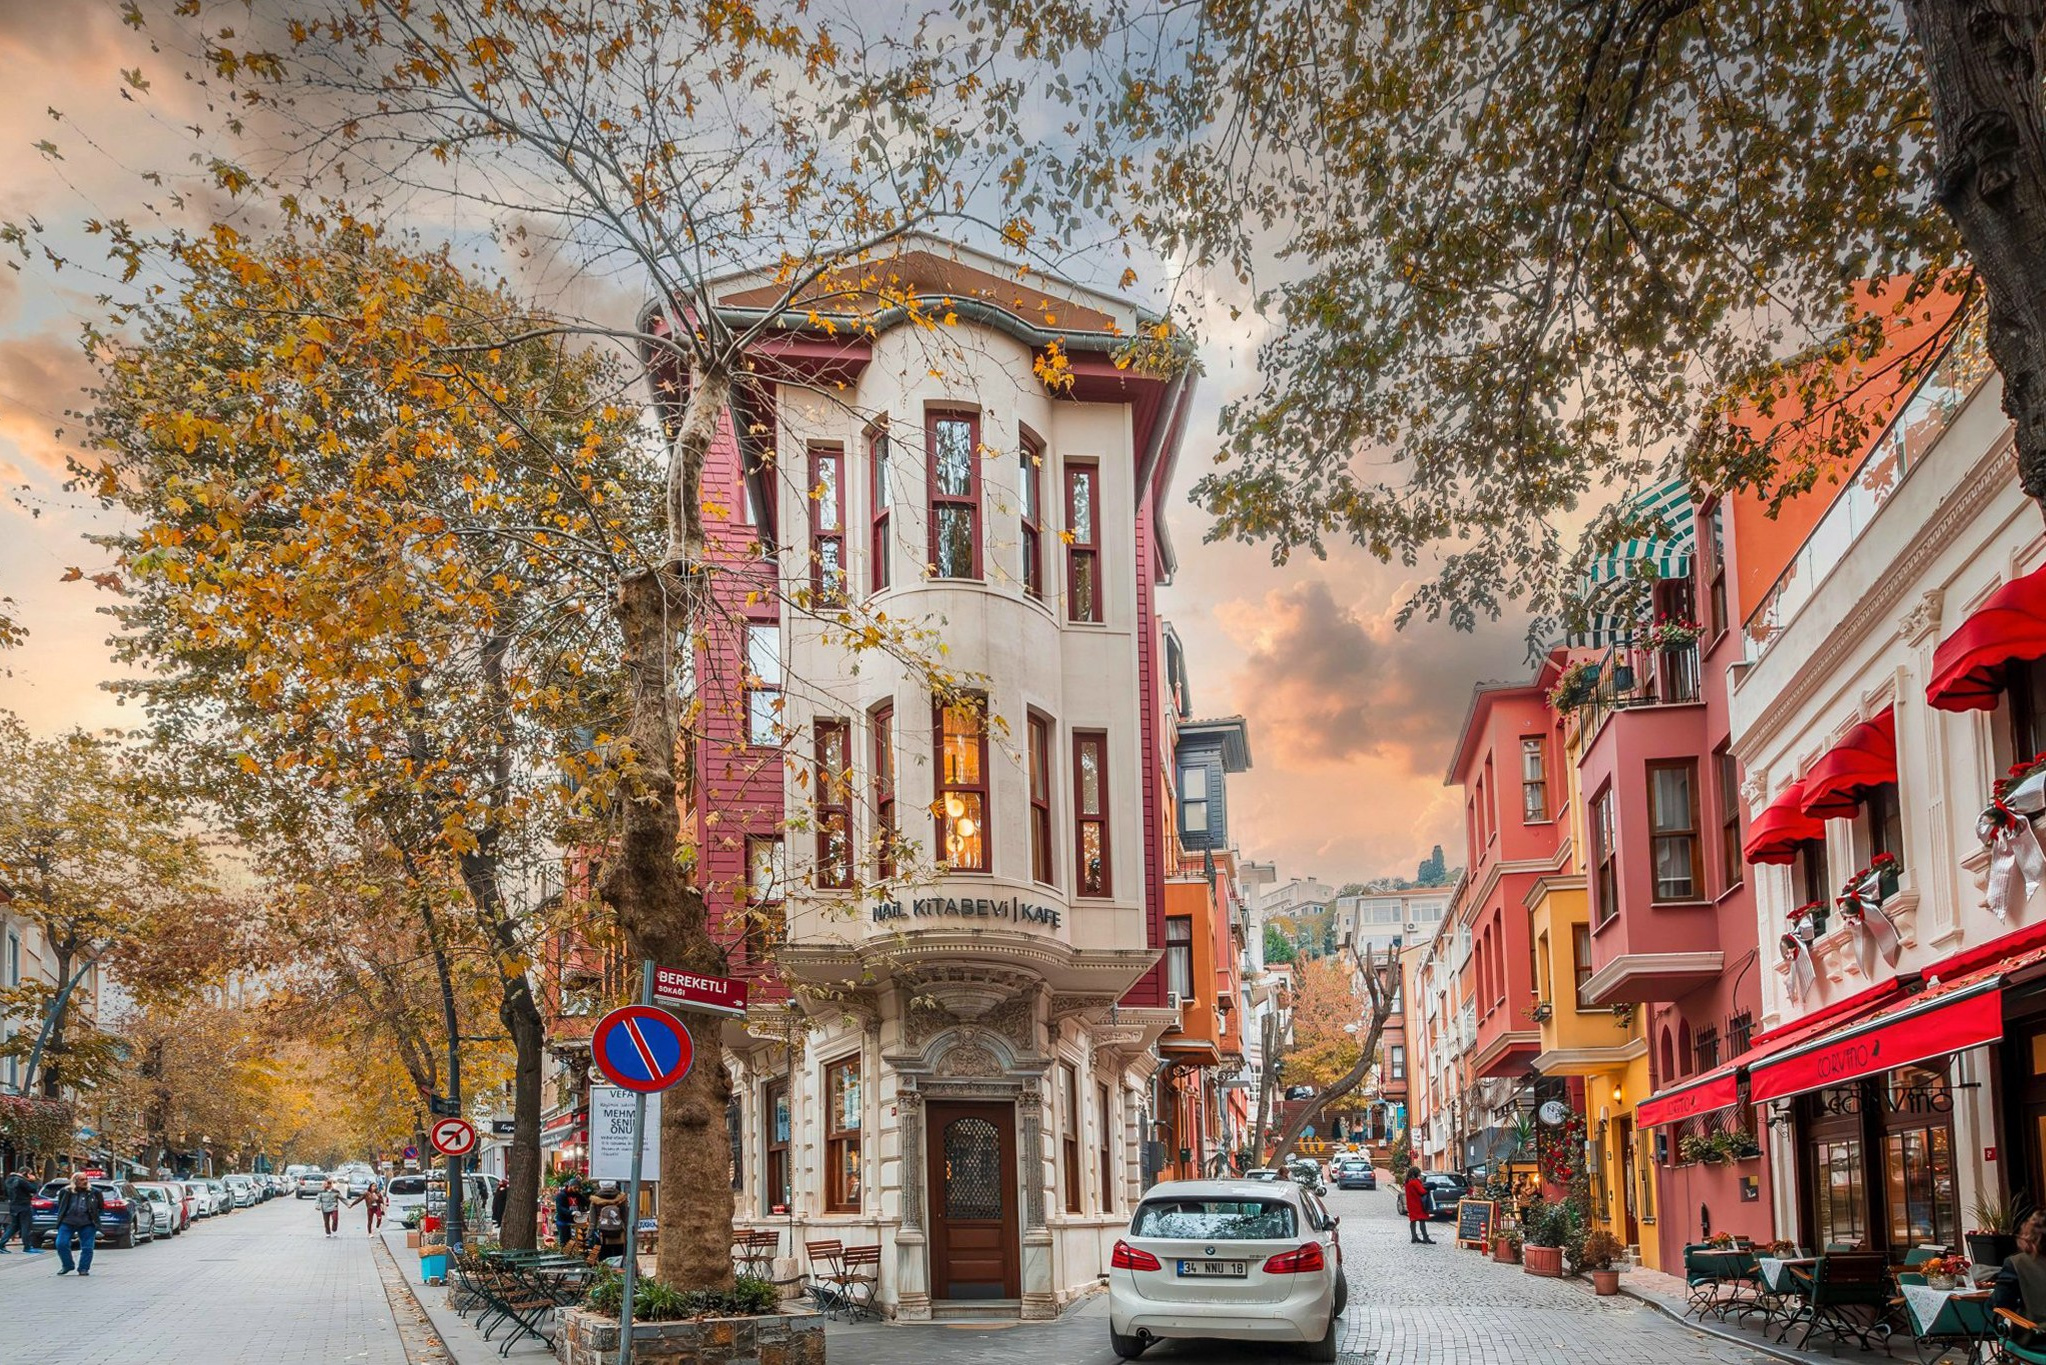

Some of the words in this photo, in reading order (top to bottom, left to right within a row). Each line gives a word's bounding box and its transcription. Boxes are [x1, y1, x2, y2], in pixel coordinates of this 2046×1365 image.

[1021, 903, 1061, 929] KAFE
[659, 970, 728, 994] BEREKETLİ
[658, 985, 686, 997] SOKAĞI
[610, 1090, 634, 1098] VEFA
[604, 1109, 636, 1118] MEHM
[610, 1126, 633, 1135] ONU
[1184, 1262, 1196, 1273] 34
[1205, 1263, 1223, 1273] NNU
[1231, 1263, 1243, 1273] 18
